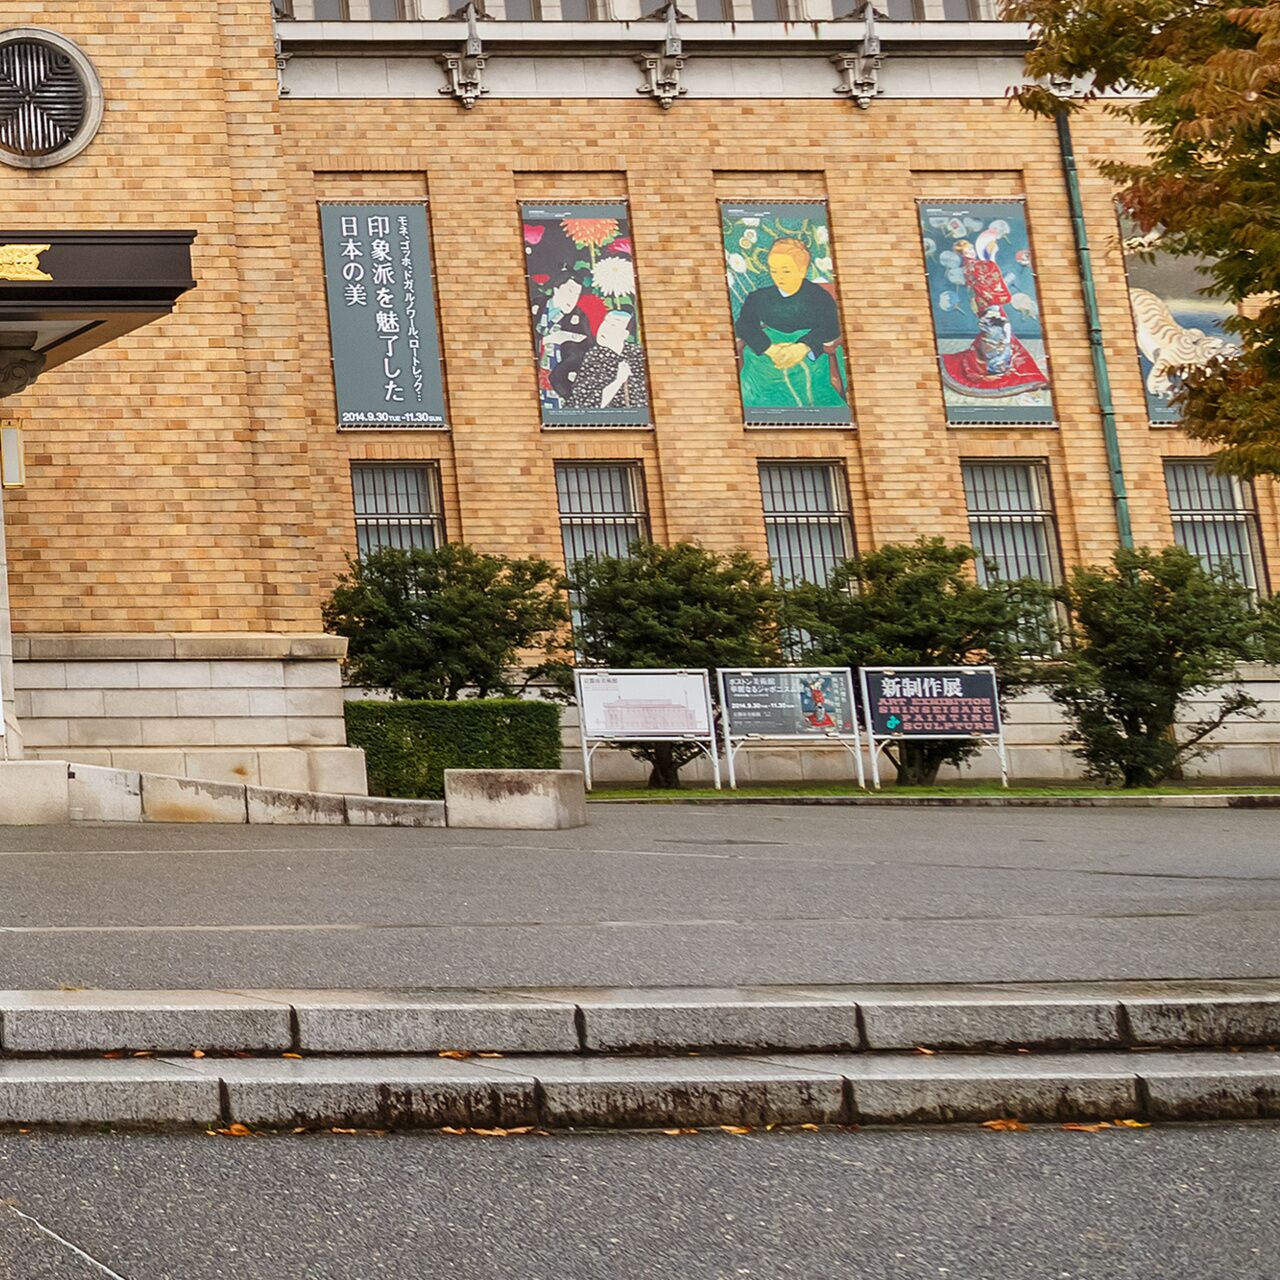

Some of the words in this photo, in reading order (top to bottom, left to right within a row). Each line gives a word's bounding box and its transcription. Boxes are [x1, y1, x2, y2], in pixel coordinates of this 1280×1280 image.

[340, 215, 368, 307] 日本の美
[367, 215, 404, 402] 印象派を魅了した
[881, 677, 963, 698] 新制作展
[911, 697, 991, 705] EXHIBITION
[878, 705, 992, 714] SHINSEISAKU
[901, 714, 994, 722] PAINTING
[903, 722, 995, 730] SCULPTURE
